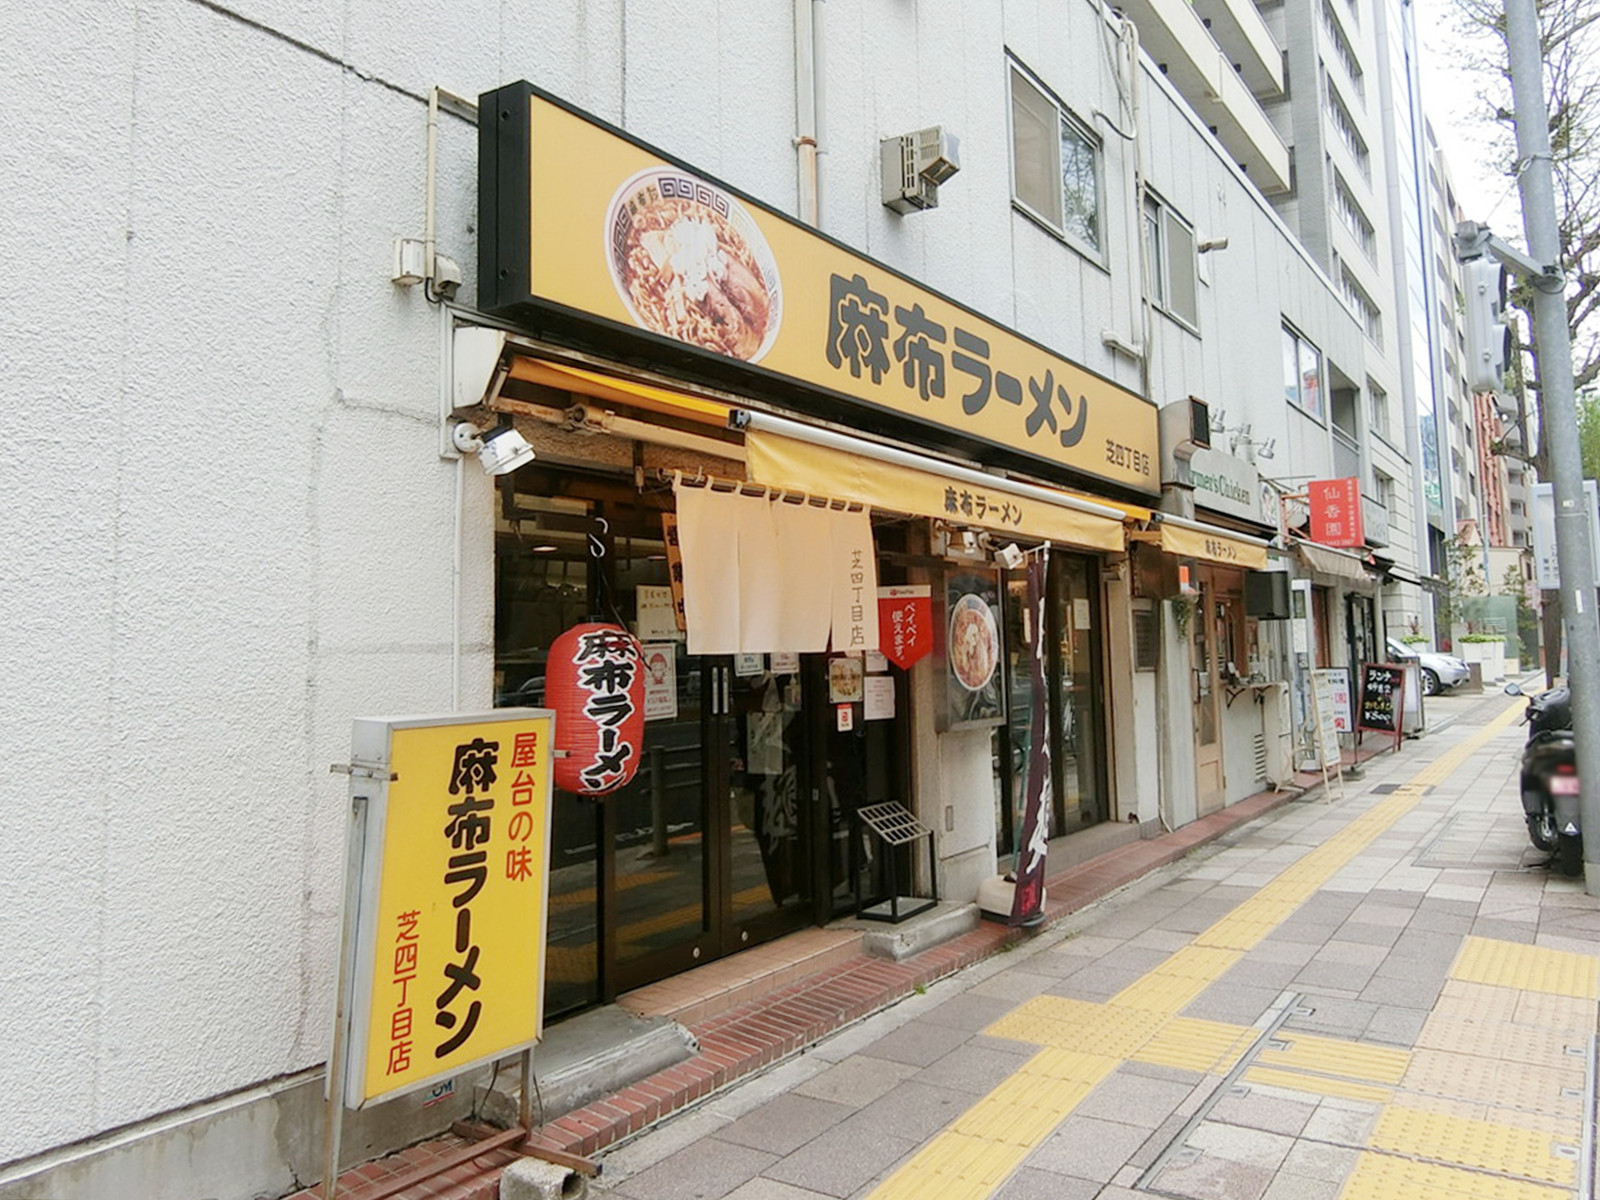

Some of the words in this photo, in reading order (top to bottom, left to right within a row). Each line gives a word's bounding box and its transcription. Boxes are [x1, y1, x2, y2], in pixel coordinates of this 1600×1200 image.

[825, 273, 1088, 449] 麻布ラーメン
[944, 485, 1023, 526] 麻布ラーメン
[1105, 438, 1150, 476] 芝四丁目店
[1190, 469, 1218, 493] rmer's
[1219, 474, 1251, 506] Chicken
[850, 549, 866, 647] 芝四丁目店
[904, 602, 917, 647] ペイペイ
[572, 629, 640, 795] 麻布ラーメン
[505, 732, 538, 883] 屋台の味
[434, 737, 500, 1059] 麻布ラーメン
[386, 909, 421, 1076] 芝四丁目店
